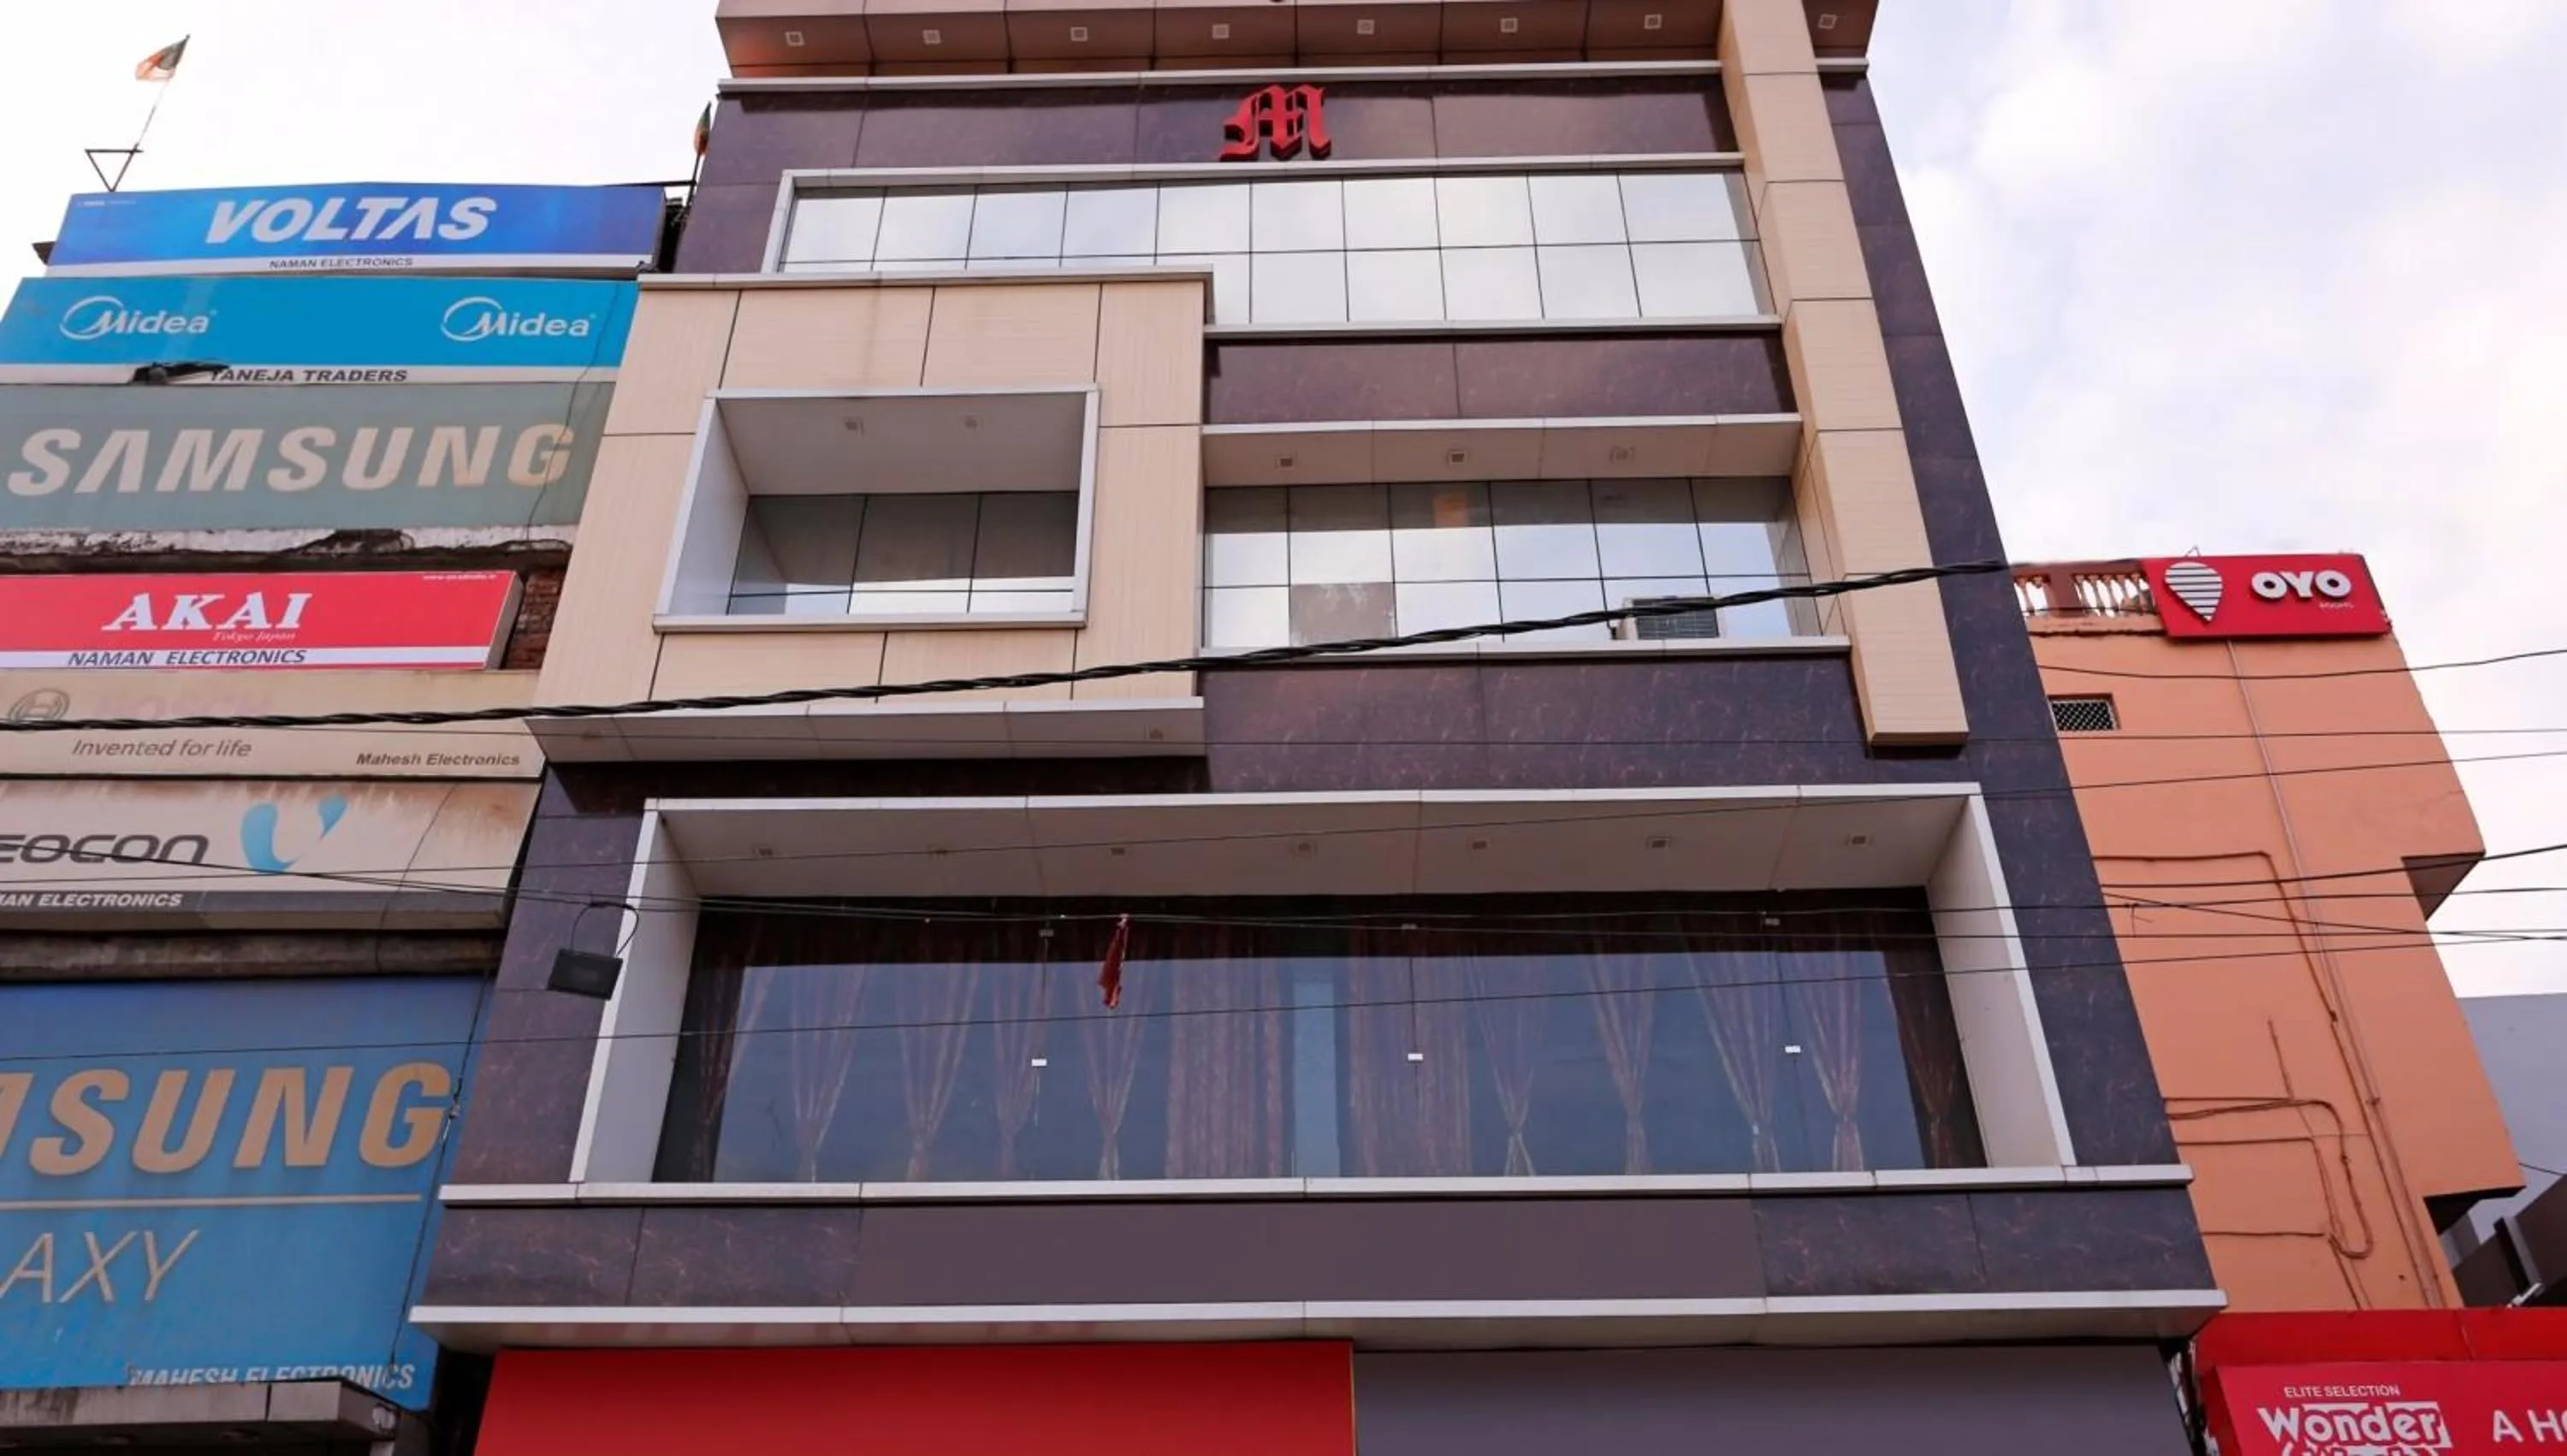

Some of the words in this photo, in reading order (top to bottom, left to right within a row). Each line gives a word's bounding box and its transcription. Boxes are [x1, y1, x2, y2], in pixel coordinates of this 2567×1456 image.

[205, 197, 497, 244] VOLTAS
[270, 259, 317, 269] NAMAN
[321, 257, 413, 268] ELECTRONICS
[79, 308, 210, 335] Midea
[461, 310, 590, 337] Midea
[303, 370, 408, 382] TRADERS
[7, 423, 574, 497] SAMSUNG
[2251, 570, 2352, 600] OYO
[101, 591, 313, 631] AKAI
[213, 631, 254, 642] Tokyo
[256, 631, 296, 642] Japan
[68, 651, 154, 666] NAMAN
[166, 648, 307, 666] ELECTRONICS
[72, 739, 176, 757] Invented
[179, 739, 215, 756] for
[216, 740, 252, 757] life
[356, 752, 422, 766] Mahesh
[425, 752, 520, 766] Electronics
[38, 892, 184, 907] ELECTRONICS
[0, 1062, 451, 1176] SUNG
[2284, 1386, 2322, 1398] ELITE
[2324, 1384, 2400, 1397] SELECTION
[2256, 1406, 2436, 1442] Wonder
[2493, 1409, 2524, 1443] A
[2527, 1409, 2567, 1443] H
